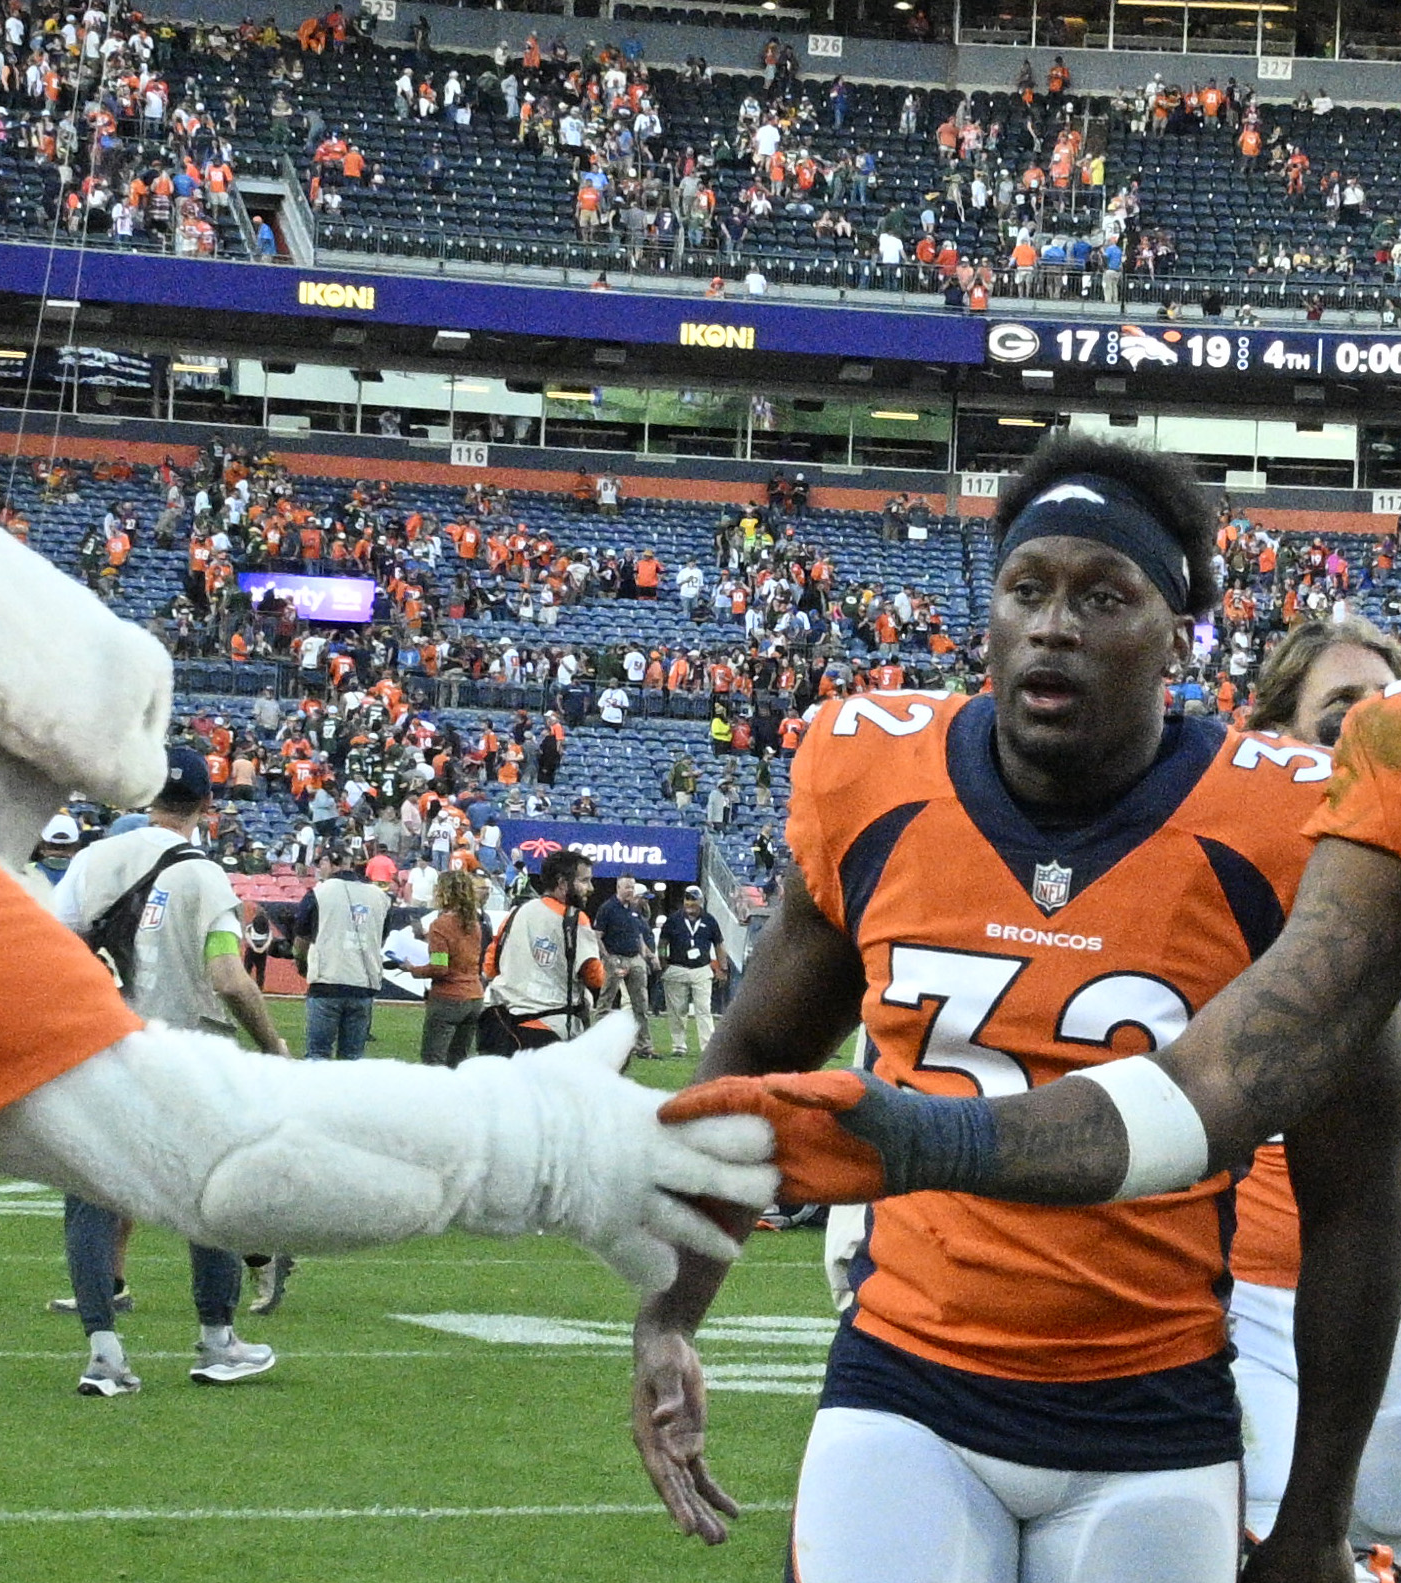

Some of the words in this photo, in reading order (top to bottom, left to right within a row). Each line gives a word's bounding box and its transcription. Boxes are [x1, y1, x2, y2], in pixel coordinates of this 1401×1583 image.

[810, 37, 842, 56] 326
[1260, 59, 1291, 77] 327
[299, 281, 365, 309] IKON
[680, 323, 741, 349] IKON
[1056, 329, 1100, 362] 17
[1187, 335, 1231, 367] 19
[1263, 340, 1310, 369] 4TH
[456, 447, 484, 463] 116
[966, 478, 995, 494] 117
[986, 923, 1103, 951] BRONCOS
